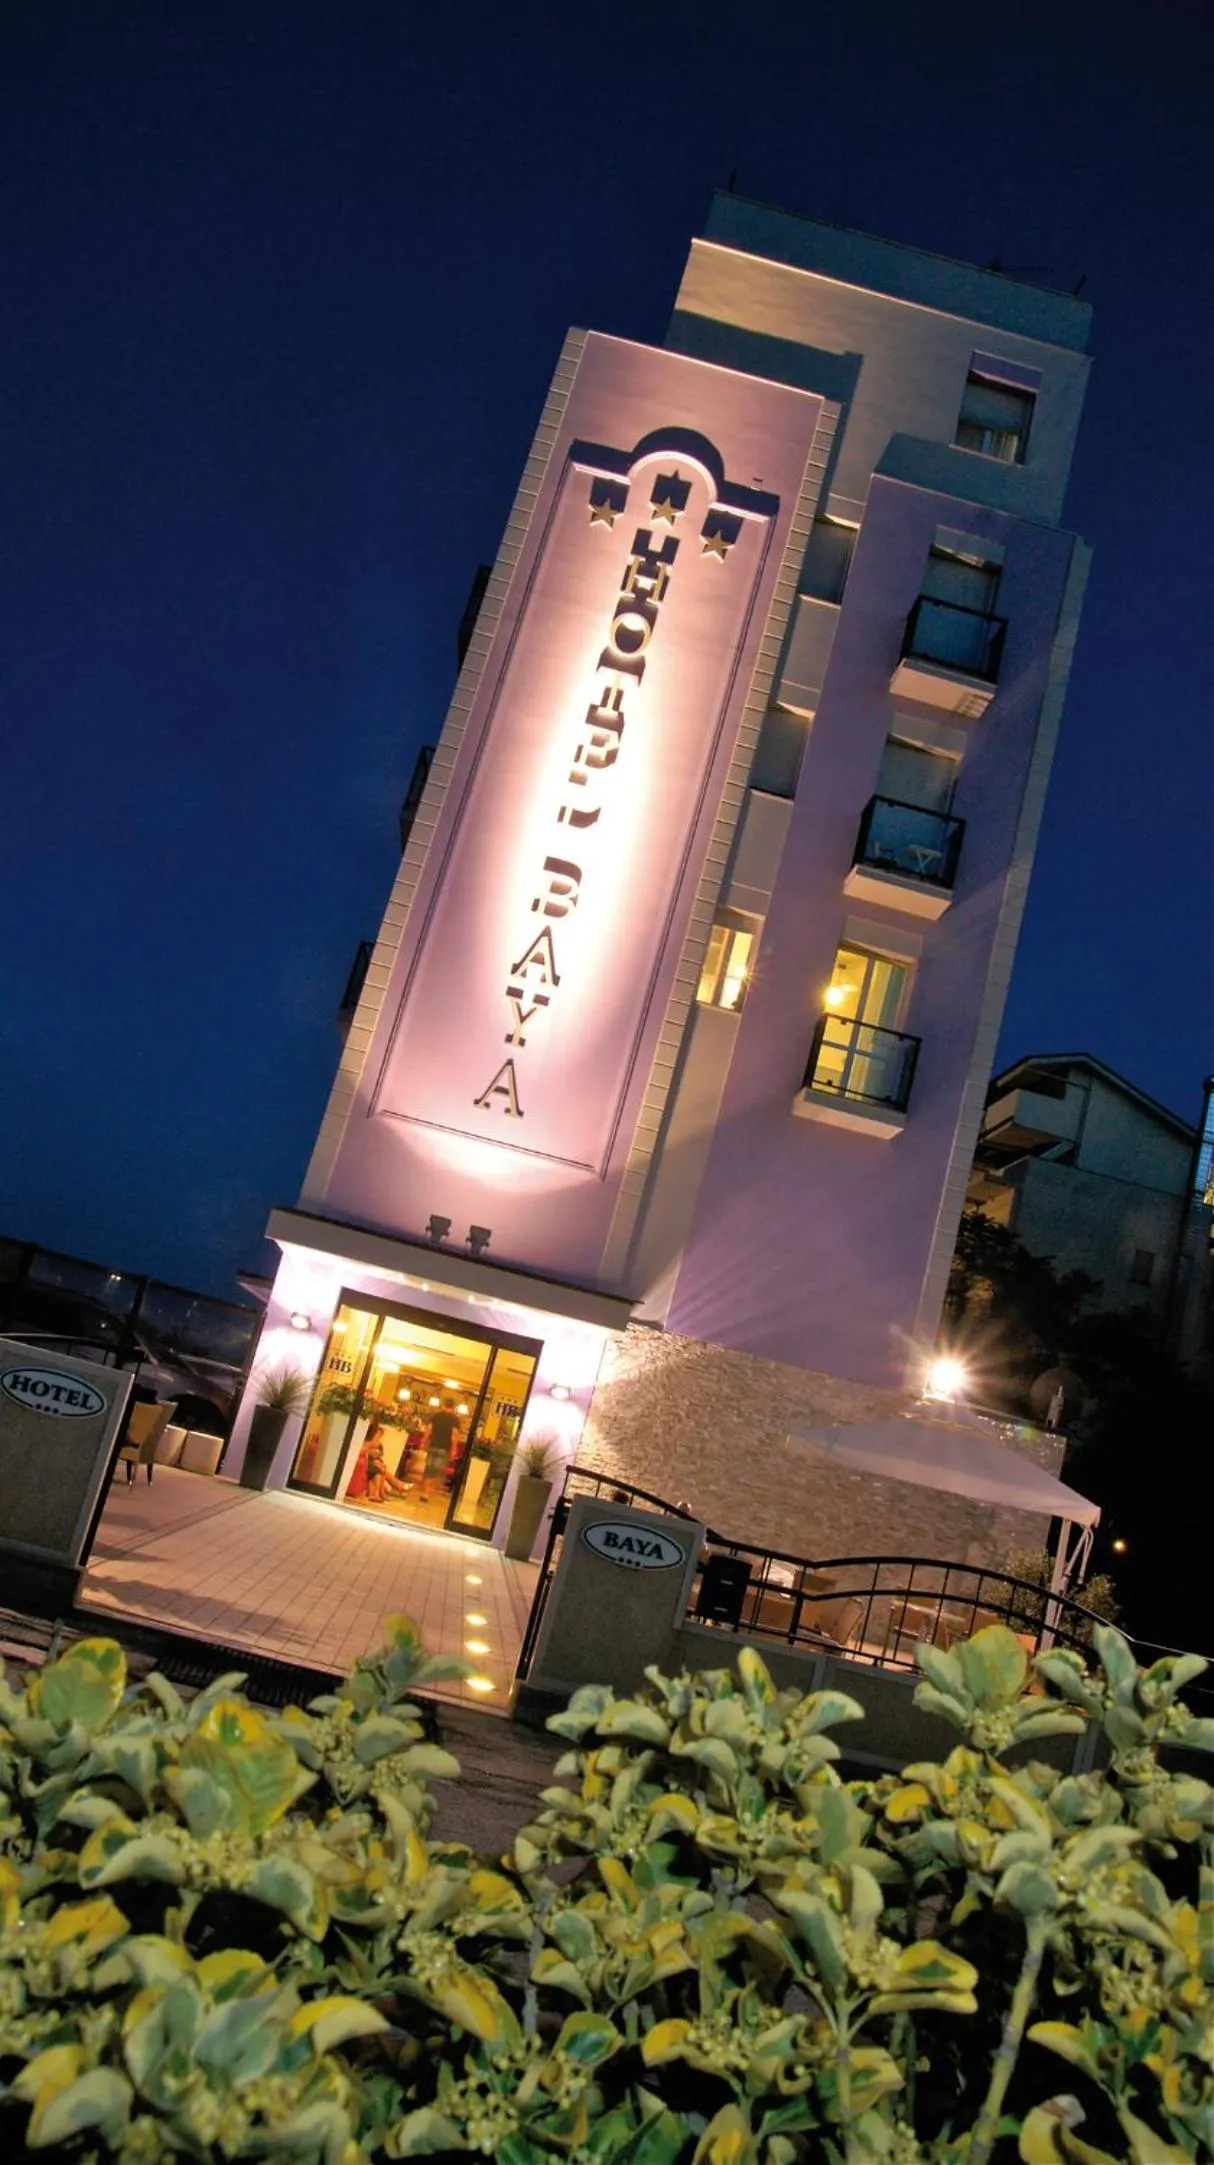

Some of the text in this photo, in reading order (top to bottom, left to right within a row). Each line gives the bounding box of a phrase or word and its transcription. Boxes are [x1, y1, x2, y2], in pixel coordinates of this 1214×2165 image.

[473, 857, 583, 1118] BAYA
[8, 1373, 95, 1411] HOTEL
[602, 1531, 664, 1561] BAYA
